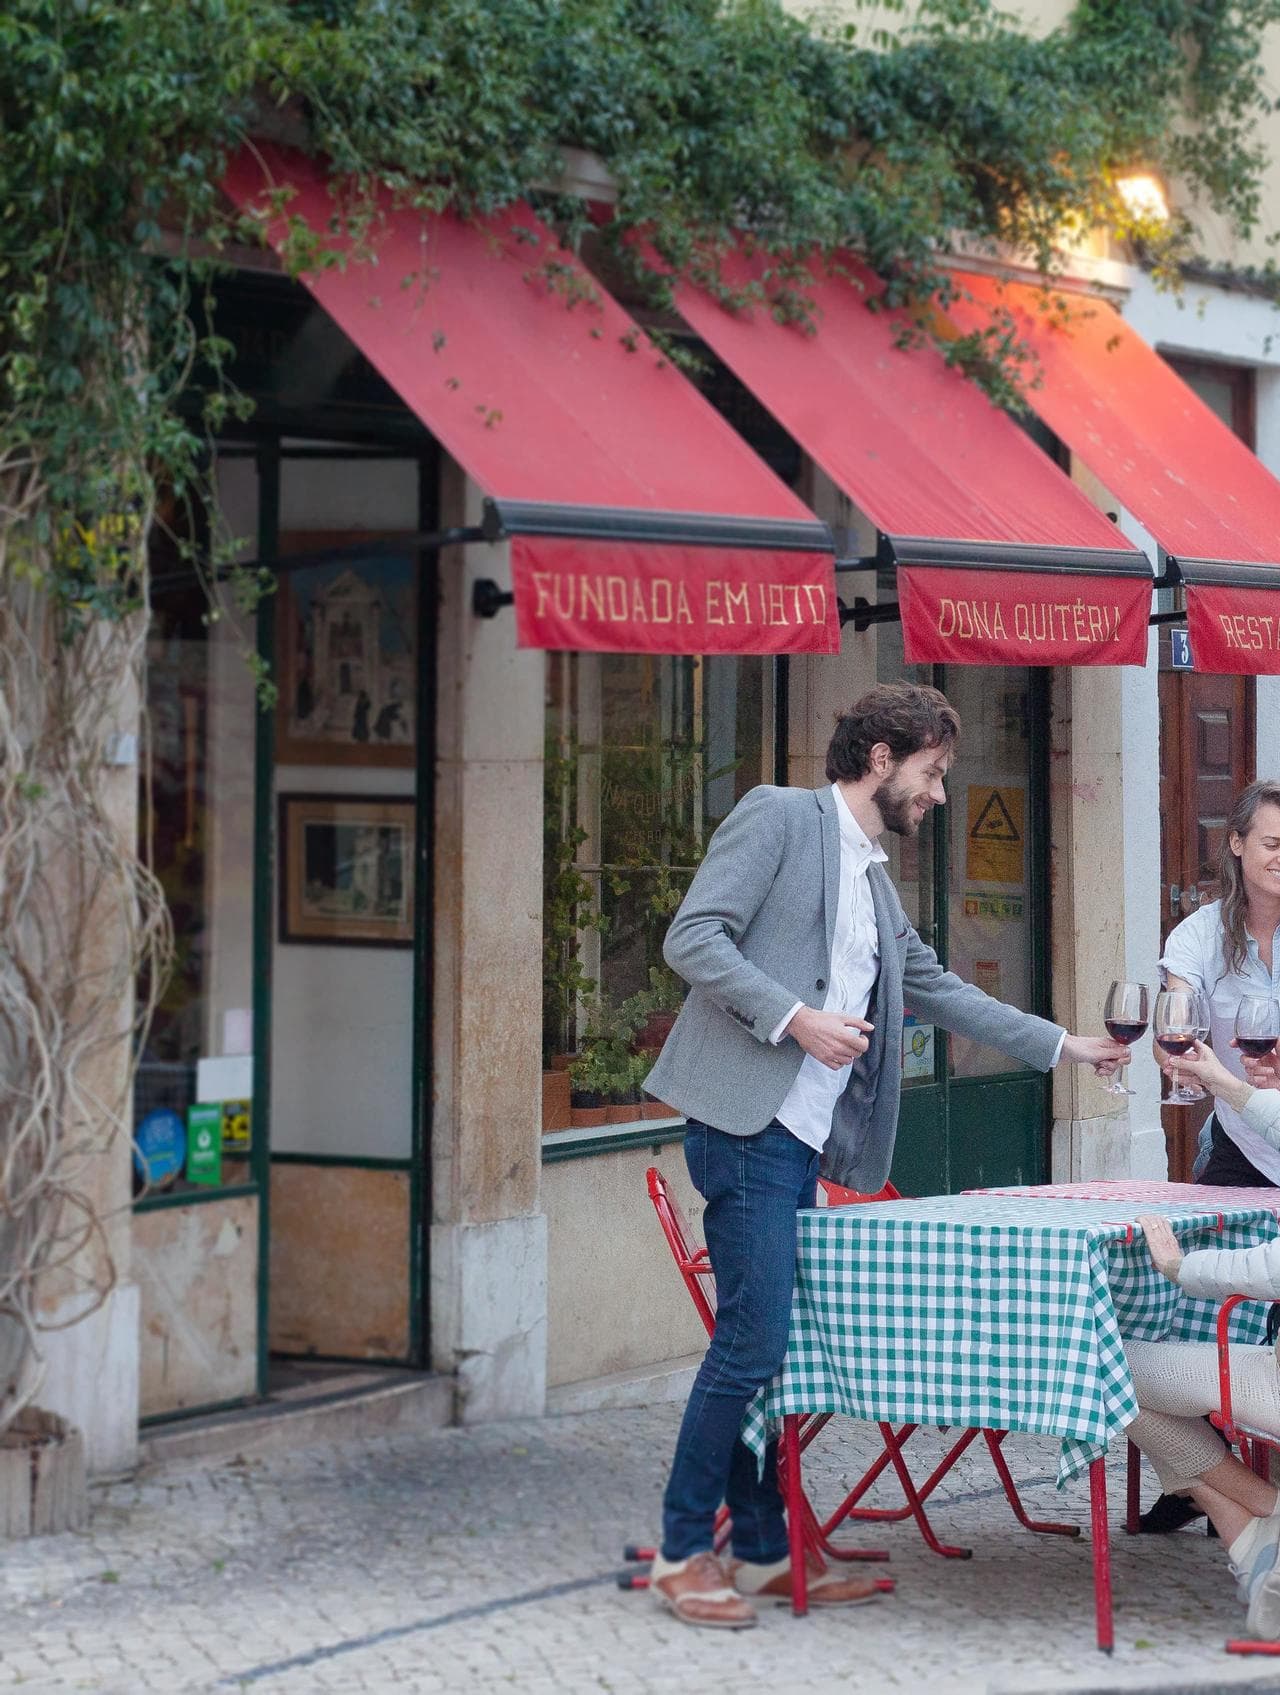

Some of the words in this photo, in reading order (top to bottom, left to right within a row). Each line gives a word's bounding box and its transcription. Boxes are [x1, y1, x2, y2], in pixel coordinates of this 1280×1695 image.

[532, 571, 694, 625] FUNDADA
[706, 581, 752, 625] EM
[758, 583, 826, 625] 1870
[938, 598, 1008, 640] DONA
[1014, 597, 1121, 643] QUITÉRIA
